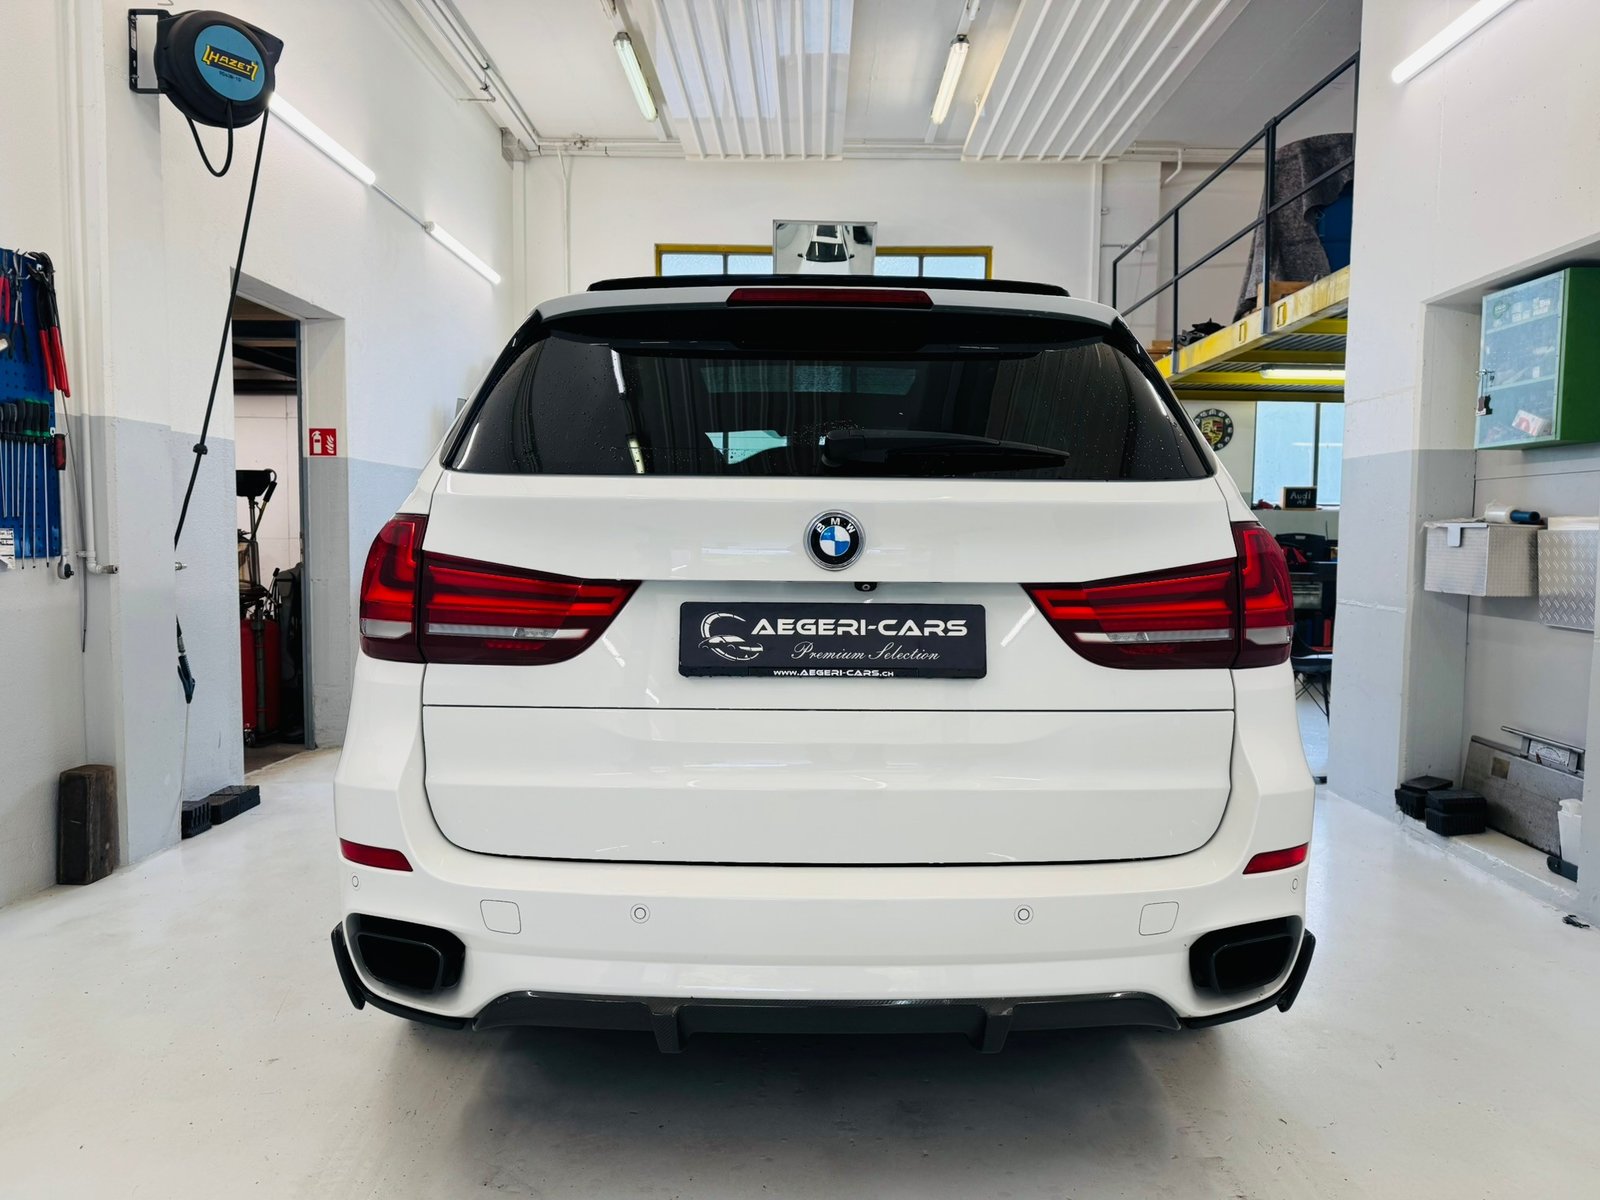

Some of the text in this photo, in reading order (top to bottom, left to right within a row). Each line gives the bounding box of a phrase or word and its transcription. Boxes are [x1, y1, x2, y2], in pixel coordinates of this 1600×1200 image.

[208, 50, 253, 72] HAZET
[1290, 490, 1311, 500] Audi
[815, 517, 856, 534] BMW
[751, 618, 968, 637] AEGERI-CARS
[791, 641, 940, 661] Premium Selection
